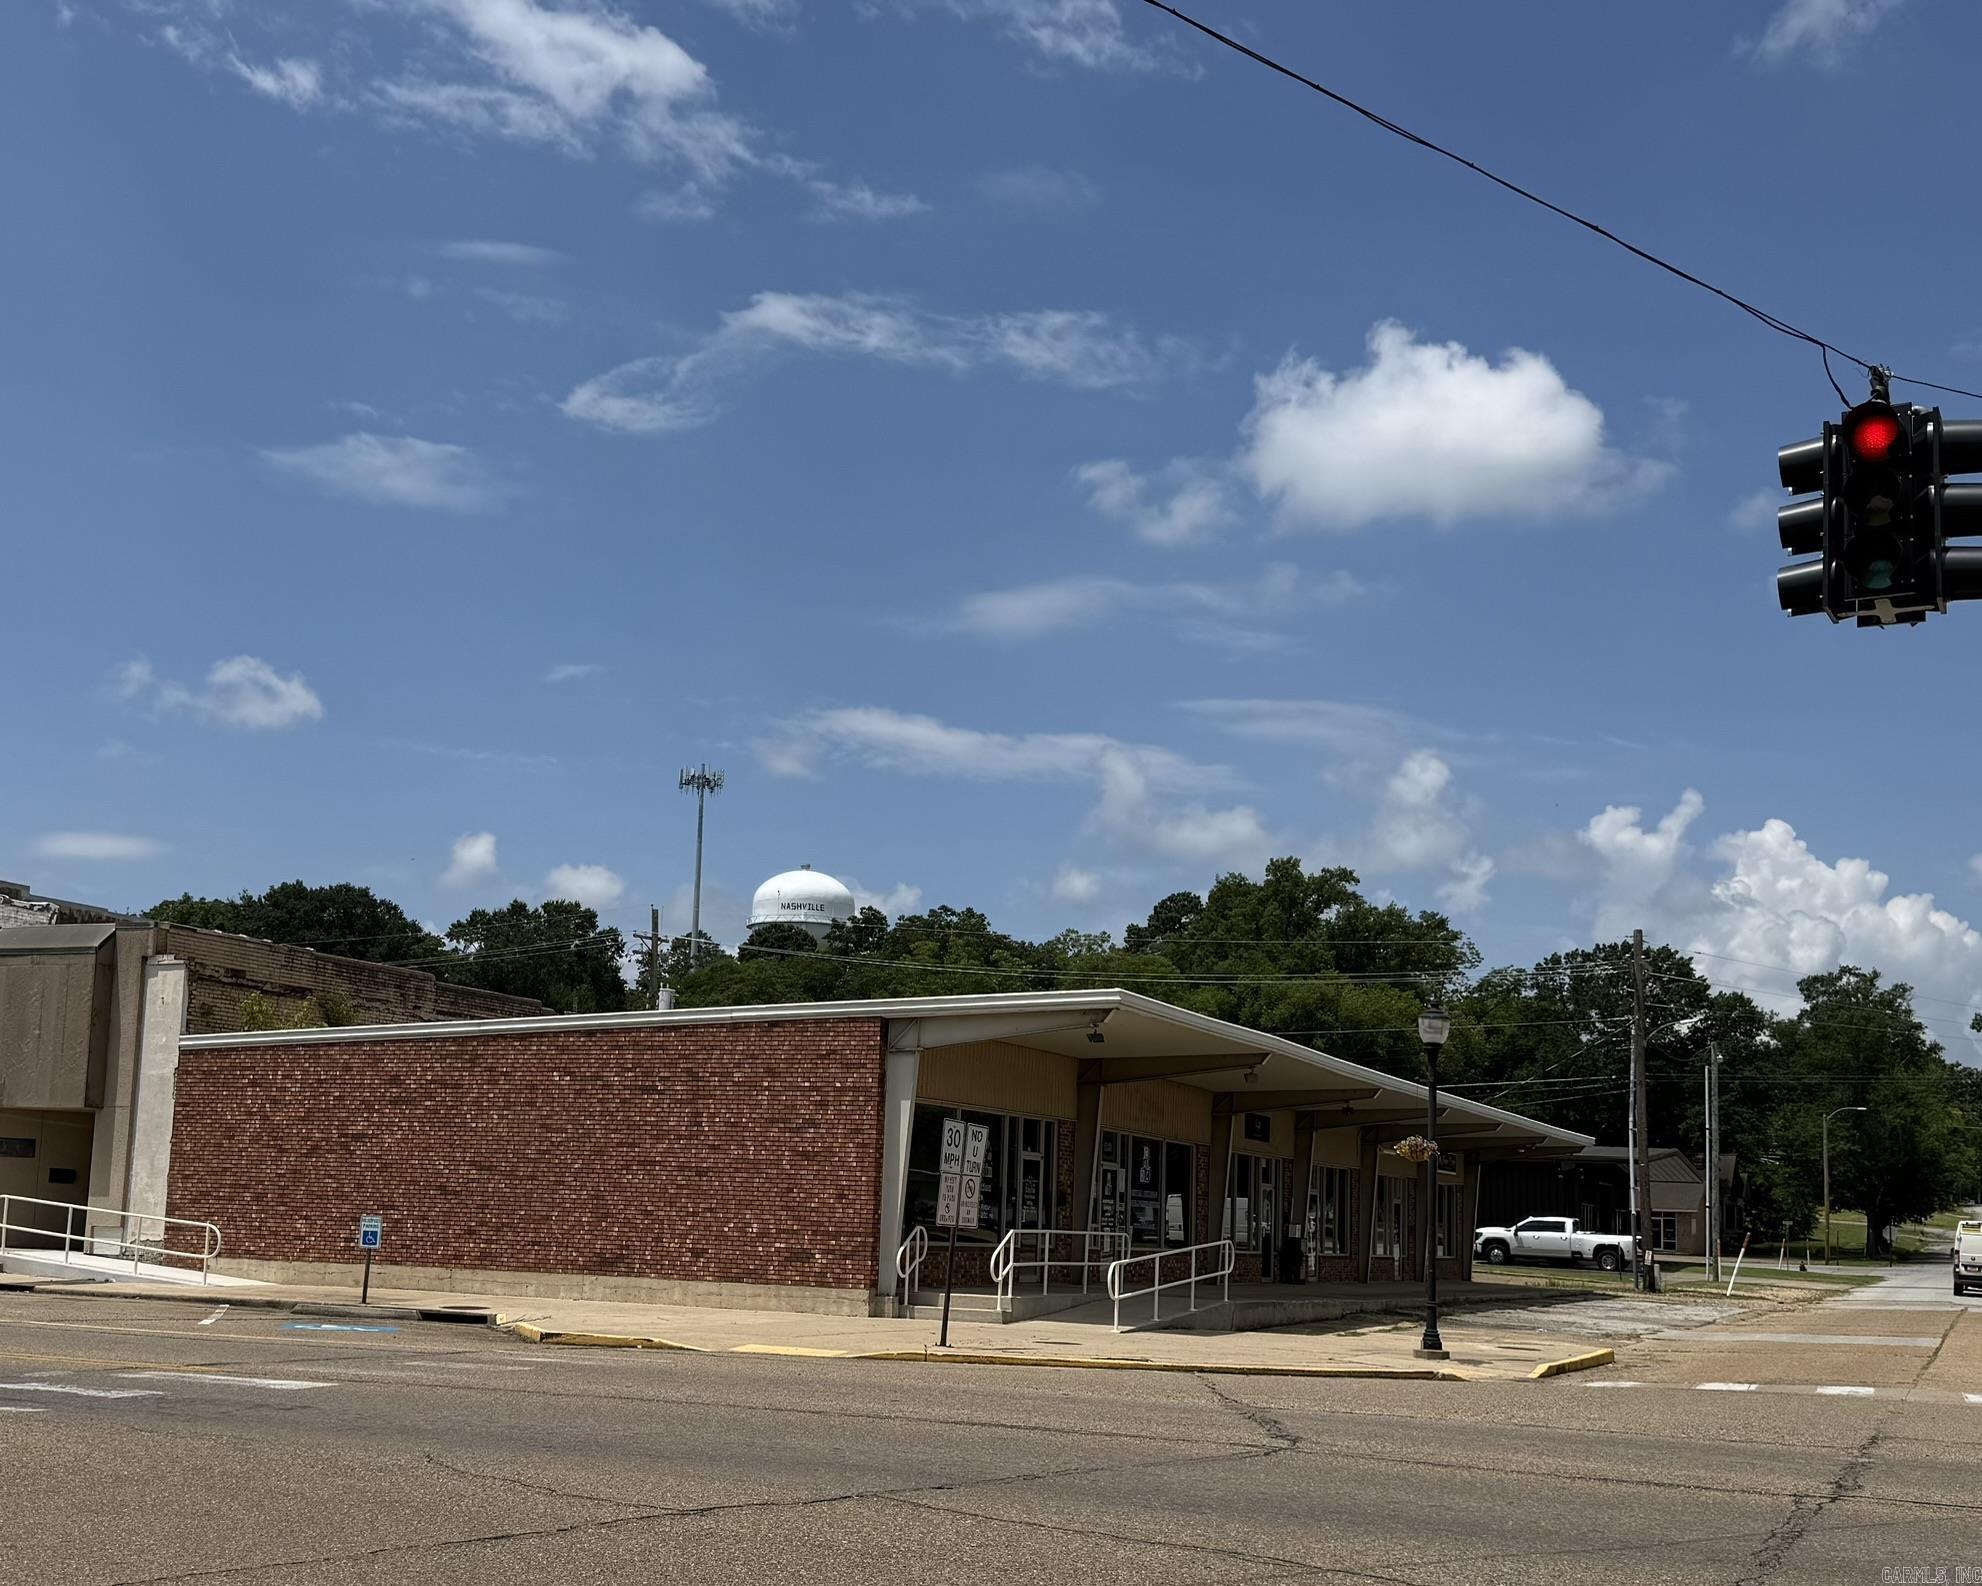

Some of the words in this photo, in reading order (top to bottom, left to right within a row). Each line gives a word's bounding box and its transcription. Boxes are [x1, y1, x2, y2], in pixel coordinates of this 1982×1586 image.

[781, 902, 825, 911] NASHVILLE
[947, 1128, 960, 1148] 30
[971, 1130, 983, 1142] NO
[973, 1146, 978, 1157] U
[944, 1152, 960, 1166] MPH
[966, 1160, 982, 1174] TURN
